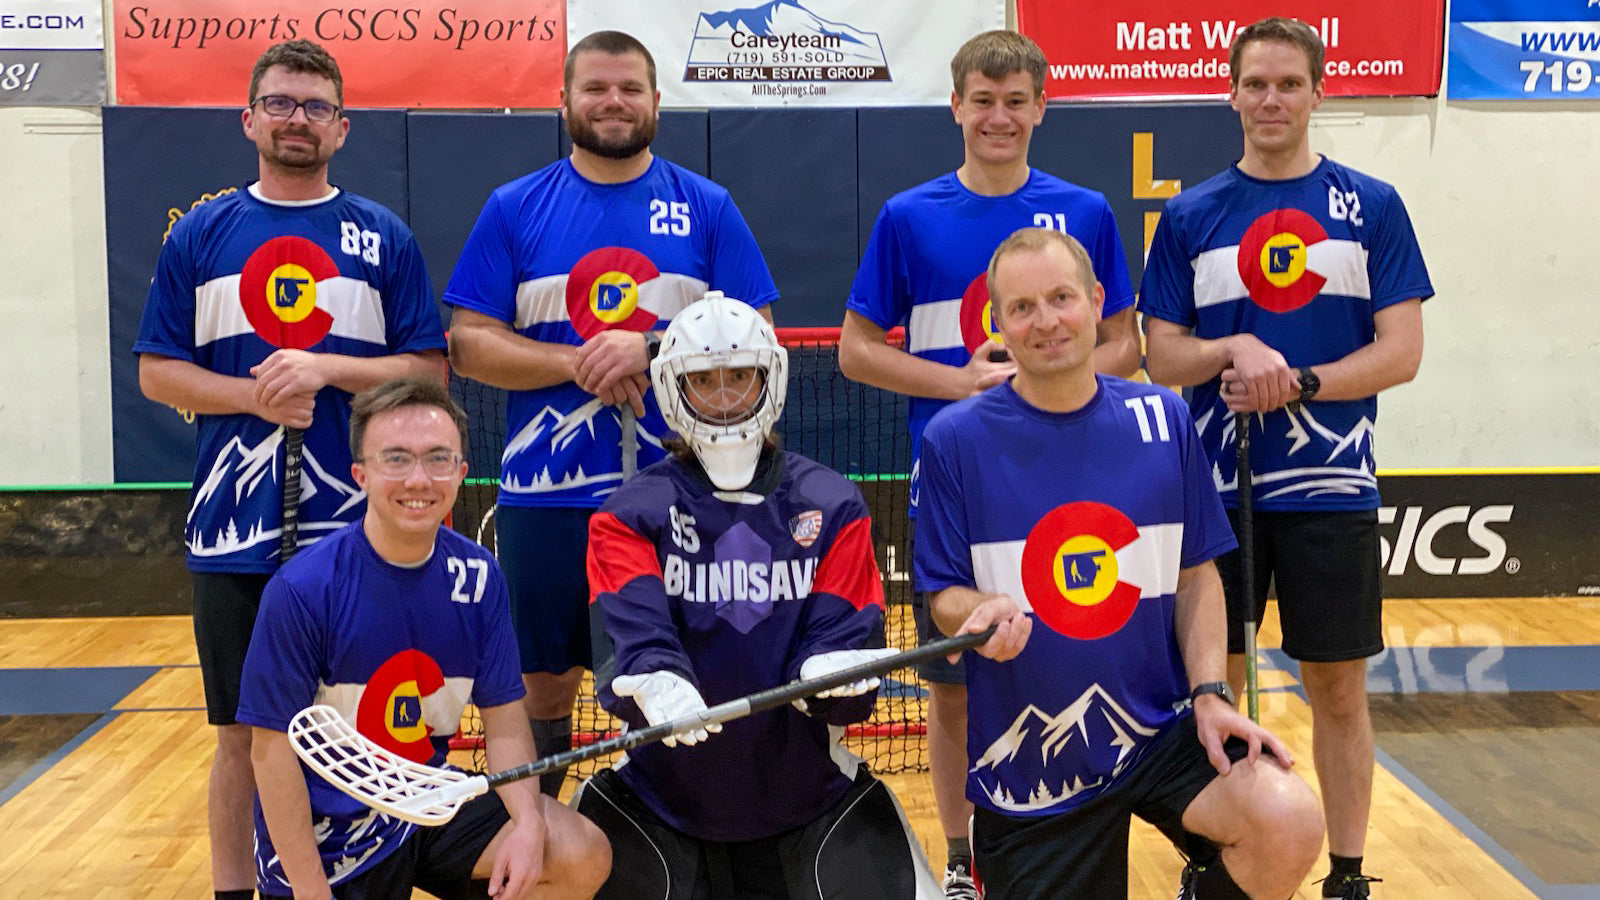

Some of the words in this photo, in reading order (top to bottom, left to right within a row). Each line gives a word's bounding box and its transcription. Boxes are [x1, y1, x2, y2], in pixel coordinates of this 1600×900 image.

[124, 6, 299, 49] Supports
[314, 8, 421, 42] CSCS
[433, 8, 556, 50] Sports
[730, 31, 841, 52] Careyteam
[1116, 21, 1193, 51] Matt
[697, 67, 728, 80] EPIC
[733, 67, 767, 80] REAL
[772, 67, 822, 80] ESTATE
[827, 66, 875, 79] GROUP
[727, 51, 764, 65] (719)
[772, 51, 844, 63] 591-SOLD
[751, 83, 827, 98] AllTheSprings.Com
[649, 198, 691, 237] 25
[340, 220, 381, 266] 89
[1124, 394, 1170, 443] 11
[668, 505, 700, 554] 95
[447, 556, 489, 604] 27
[664, 553, 818, 603] BLINDSAV
